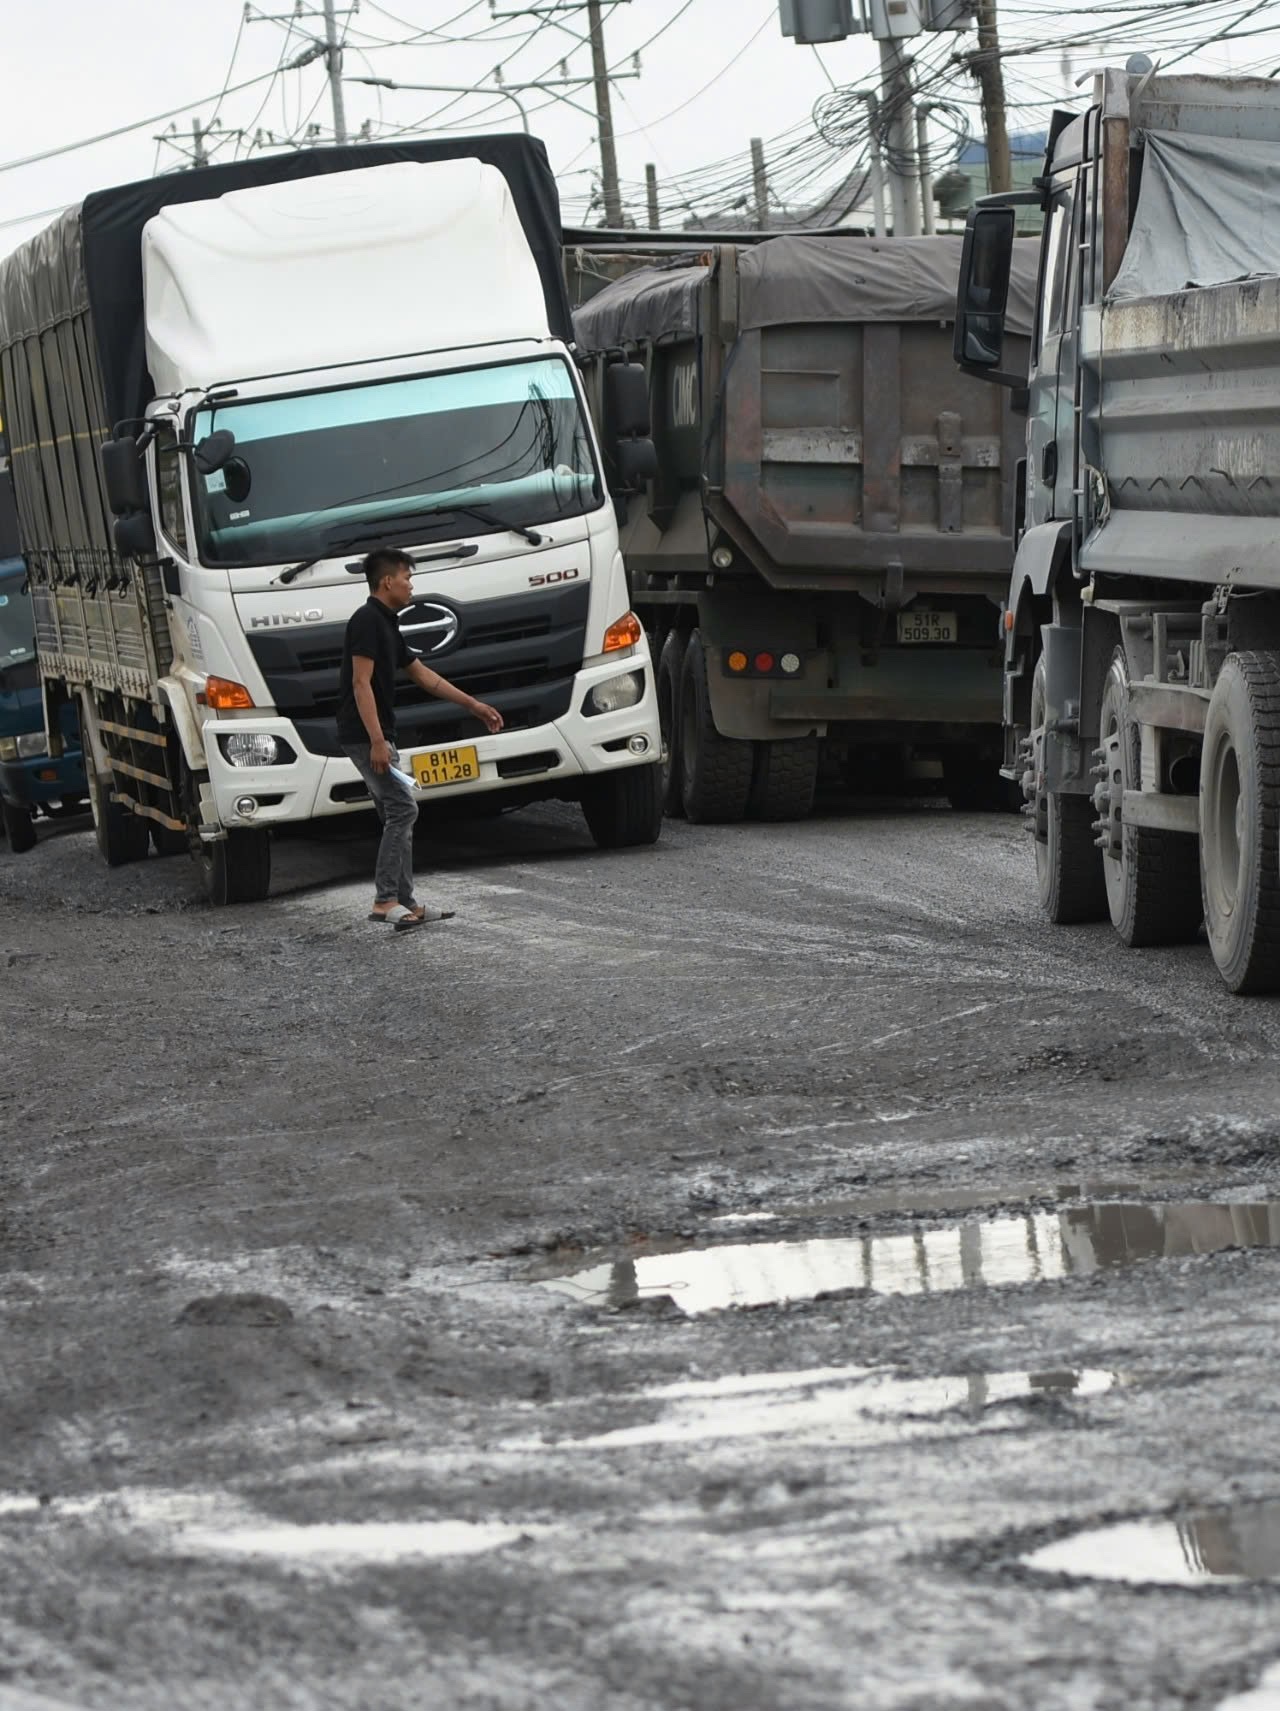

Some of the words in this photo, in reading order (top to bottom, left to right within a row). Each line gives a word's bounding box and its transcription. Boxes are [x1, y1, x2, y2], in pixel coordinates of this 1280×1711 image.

[528, 567, 579, 587] 500
[251, 608, 324, 628] HINO
[904, 627, 950, 641] 509.30
[430, 749, 459, 767] 81H
[421, 763, 472, 784] 011.28
